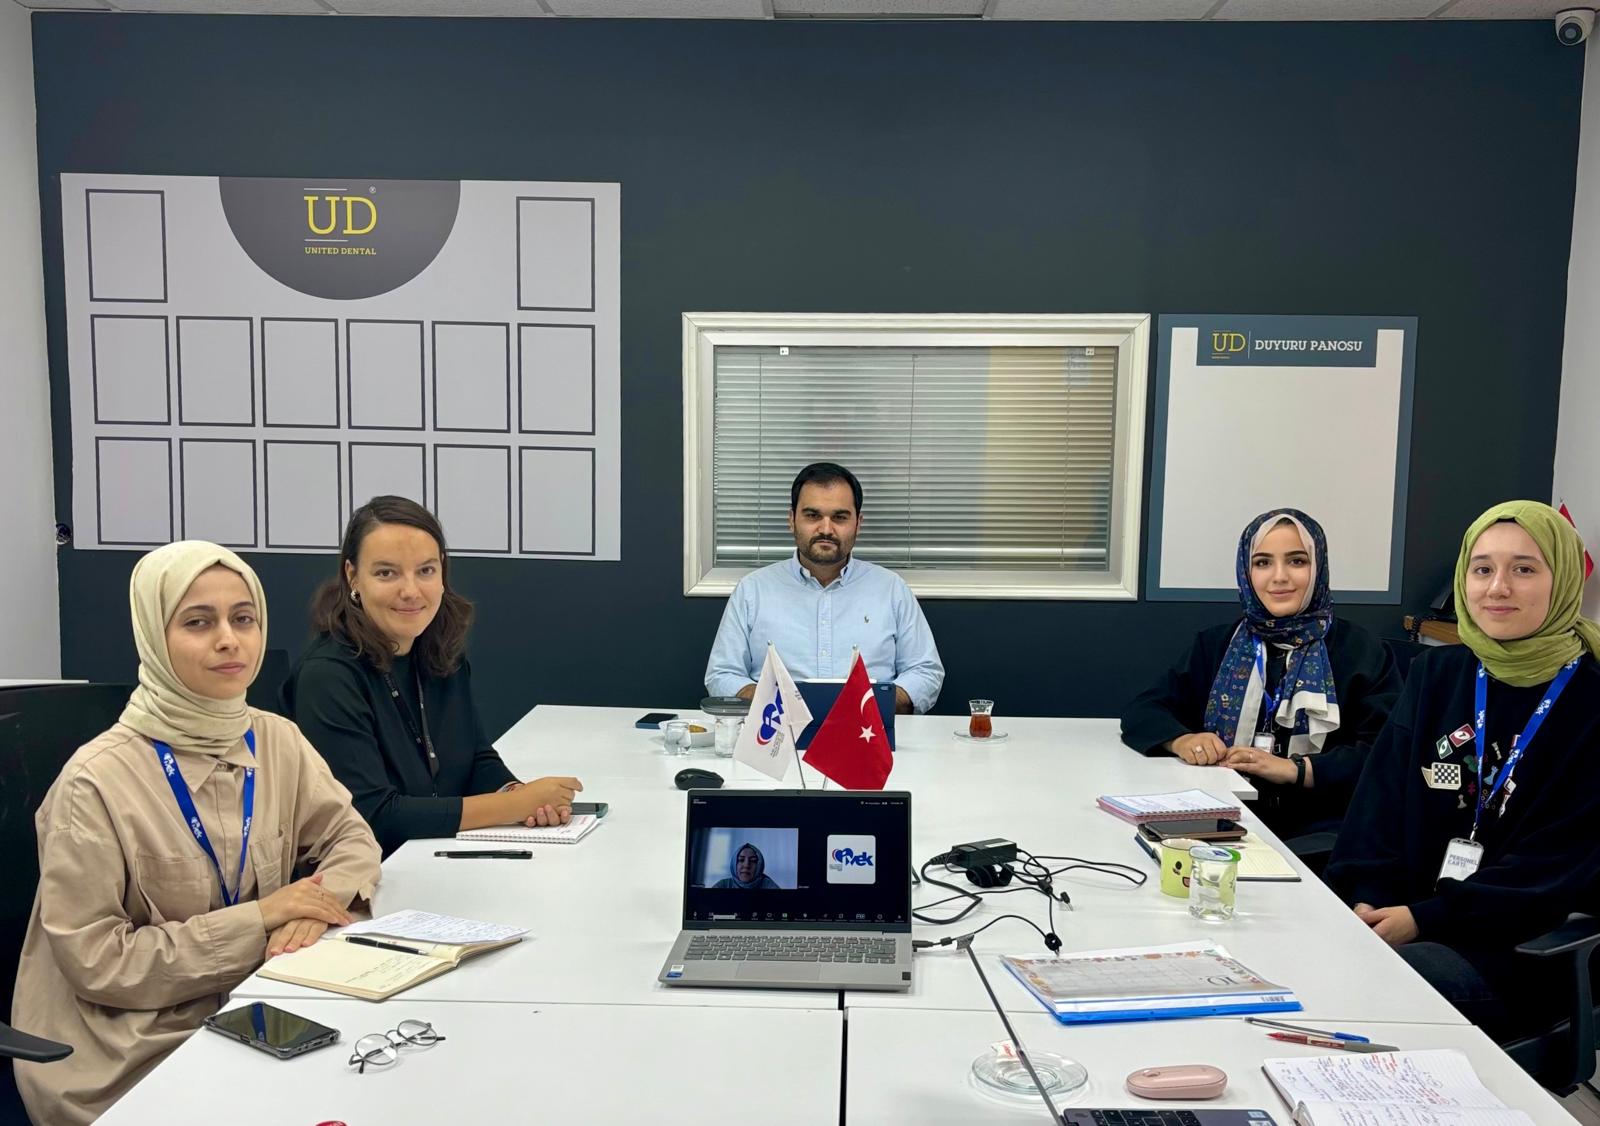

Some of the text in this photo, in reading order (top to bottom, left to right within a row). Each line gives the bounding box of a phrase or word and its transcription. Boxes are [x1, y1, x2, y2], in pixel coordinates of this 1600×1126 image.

[304, 196, 377, 235] UD
[1212, 333, 1246, 352] UD
[1255, 340, 1362, 351] DUYURU PANOSU
